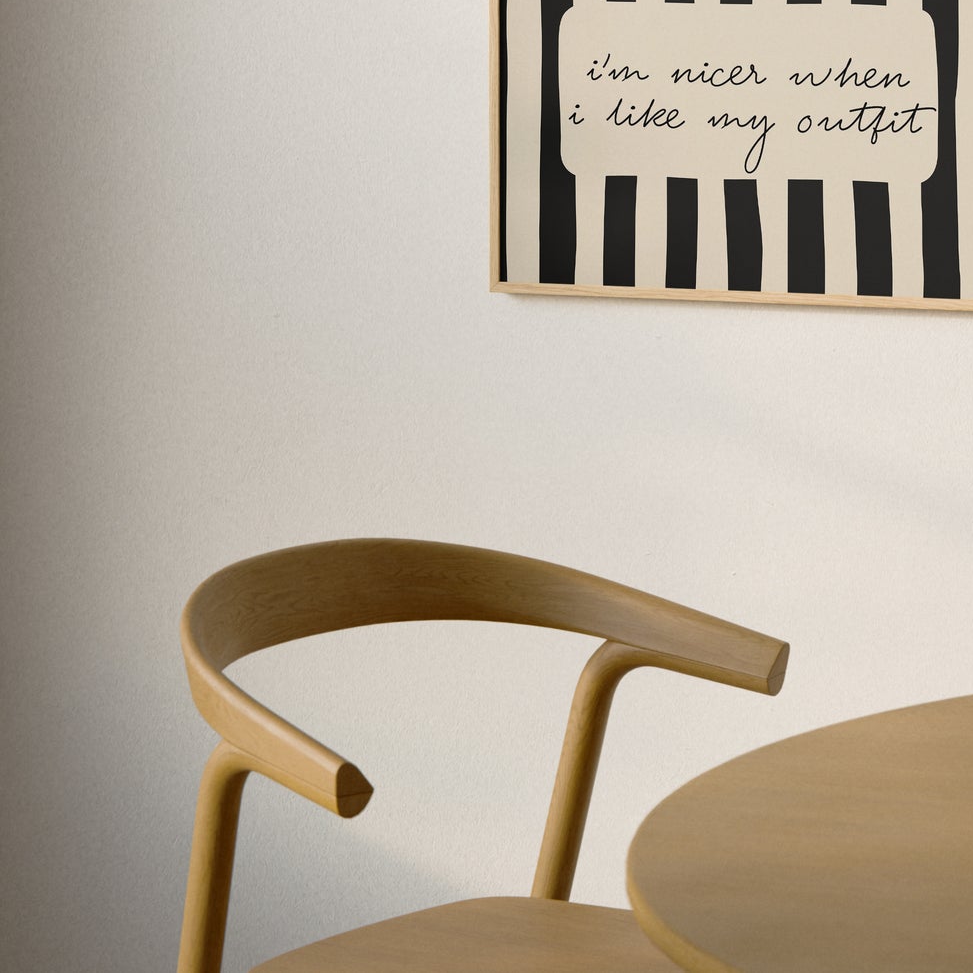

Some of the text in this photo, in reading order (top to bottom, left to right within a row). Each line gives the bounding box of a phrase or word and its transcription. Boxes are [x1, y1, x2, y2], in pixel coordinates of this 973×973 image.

[586, 53, 910, 88] i'm nicer when
[568, 98, 937, 174] i like my outfit
